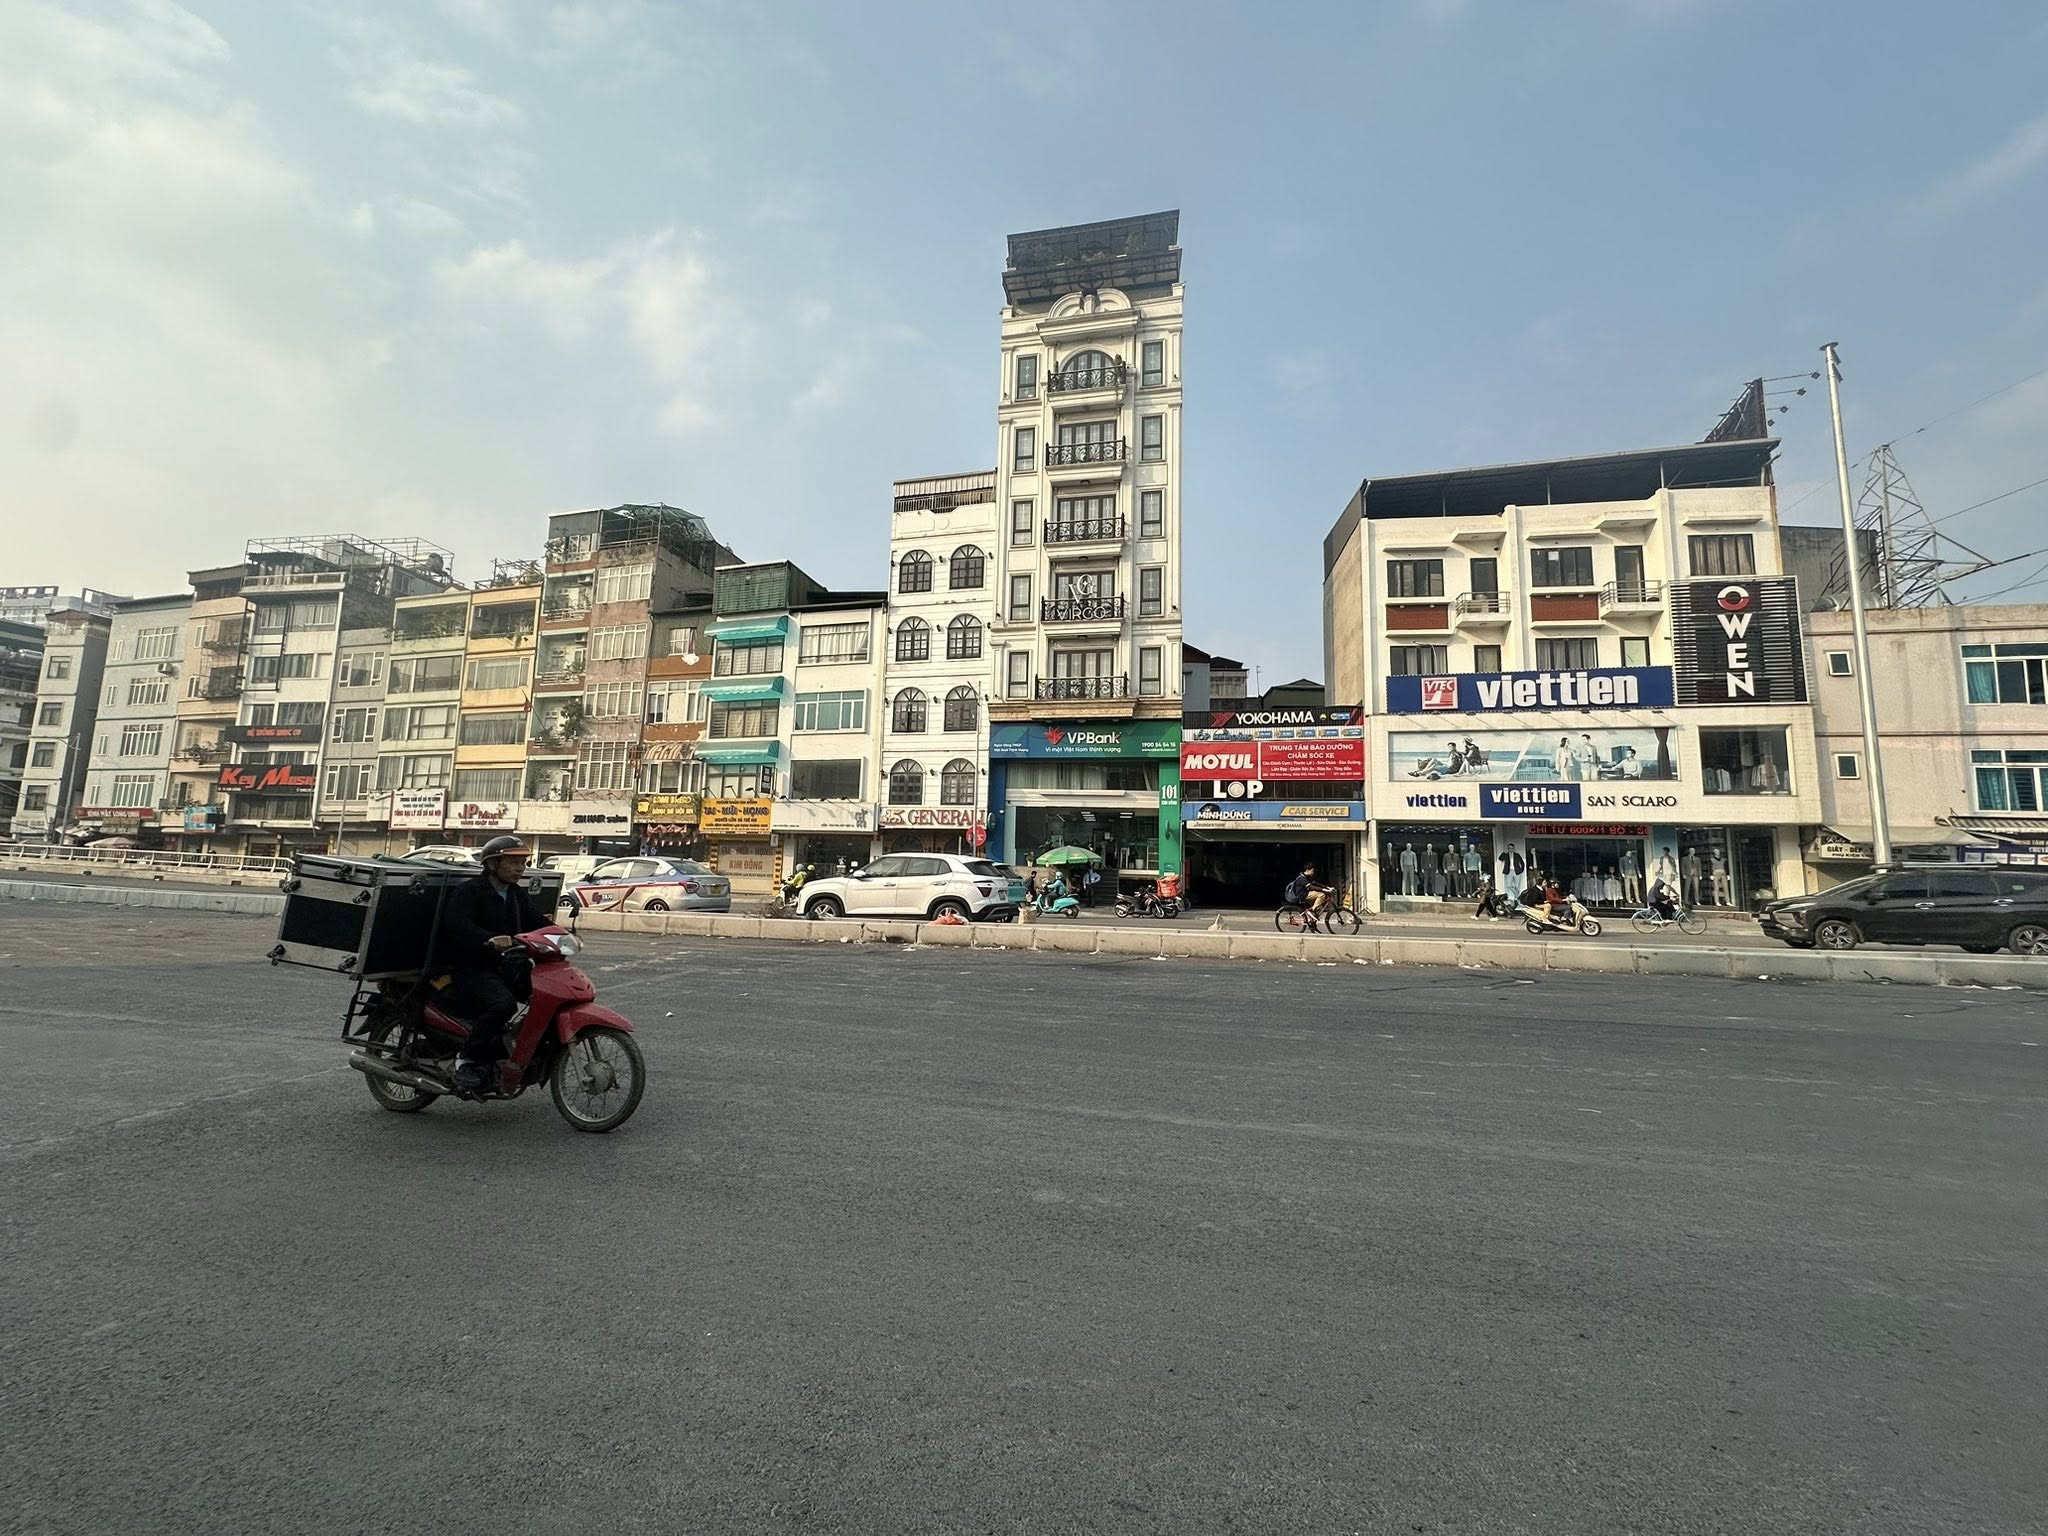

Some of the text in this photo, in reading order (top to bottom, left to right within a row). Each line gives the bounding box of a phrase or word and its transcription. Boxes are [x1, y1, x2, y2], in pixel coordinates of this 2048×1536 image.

[1057, 606, 1106, 620] VIRGO
[1717, 585, 1755, 698] OWEN
[1424, 680, 1455, 692] VTEC
[1476, 671, 1639, 708] viettien
[1236, 711, 1315, 725] YOKOHAMA
[1067, 731, 1120, 744] VPBank
[1184, 753, 1254, 770] MOTUL
[220, 768, 257, 789] Key
[1161, 784, 1178, 799] 101
[1491, 787, 1570, 804] viettien
[1406, 794, 1467, 808] viettien
[1588, 796, 1677, 807] SAN SCIARO
[458, 804, 504, 820] JP Mart
[1288, 807, 1345, 816] CAR SERVICE
[1518, 806, 1545, 814] HOUSE
[908, 809, 986, 826] GENERALI
